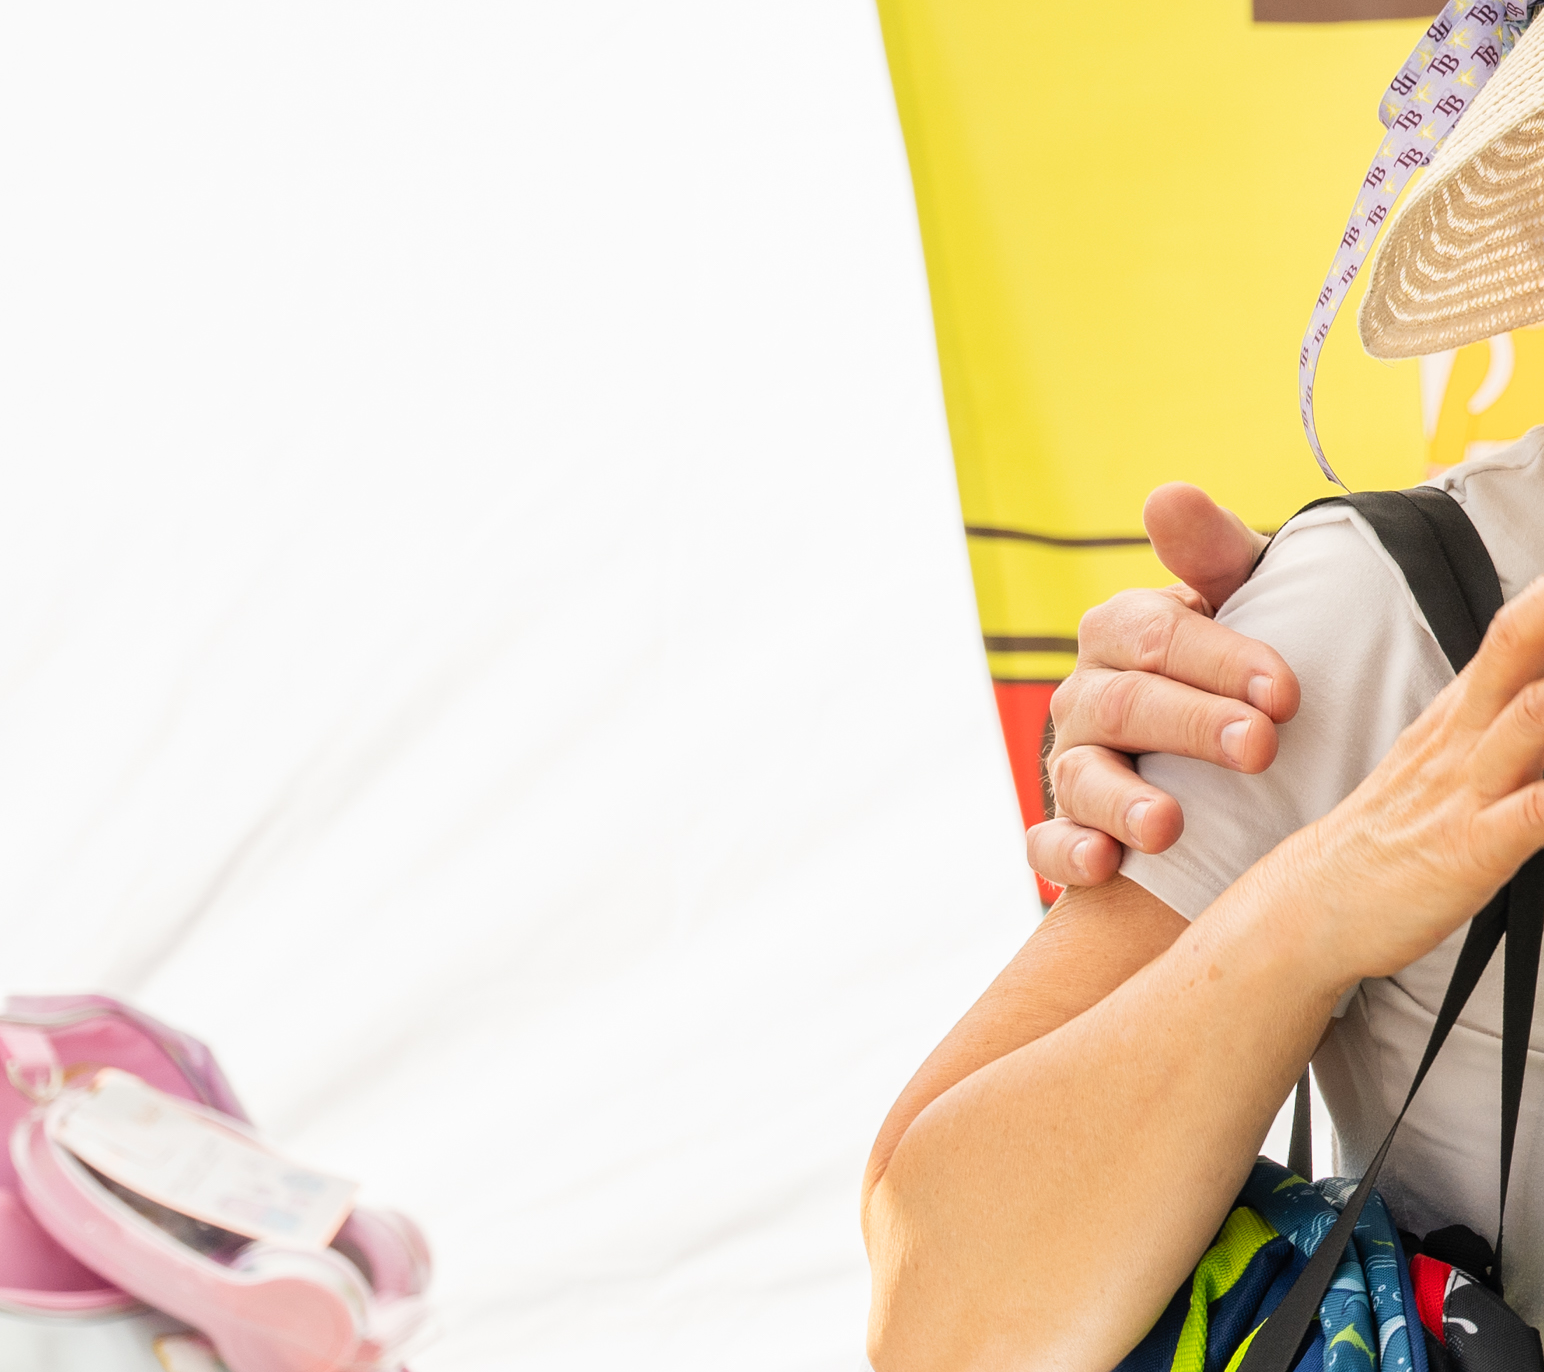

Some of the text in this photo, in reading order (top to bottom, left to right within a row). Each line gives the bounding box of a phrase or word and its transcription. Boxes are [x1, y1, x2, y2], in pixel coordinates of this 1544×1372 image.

[1362, 166, 1386, 190] TB
[1393, 109, 1423, 132] TB
[1427, 54, 1460, 77] TB
[1465, 4, 1499, 26] TB
[1393, 147, 1424, 170] TB
[1433, 94, 1465, 118] TB
[1470, 44, 1500, 68] TB
